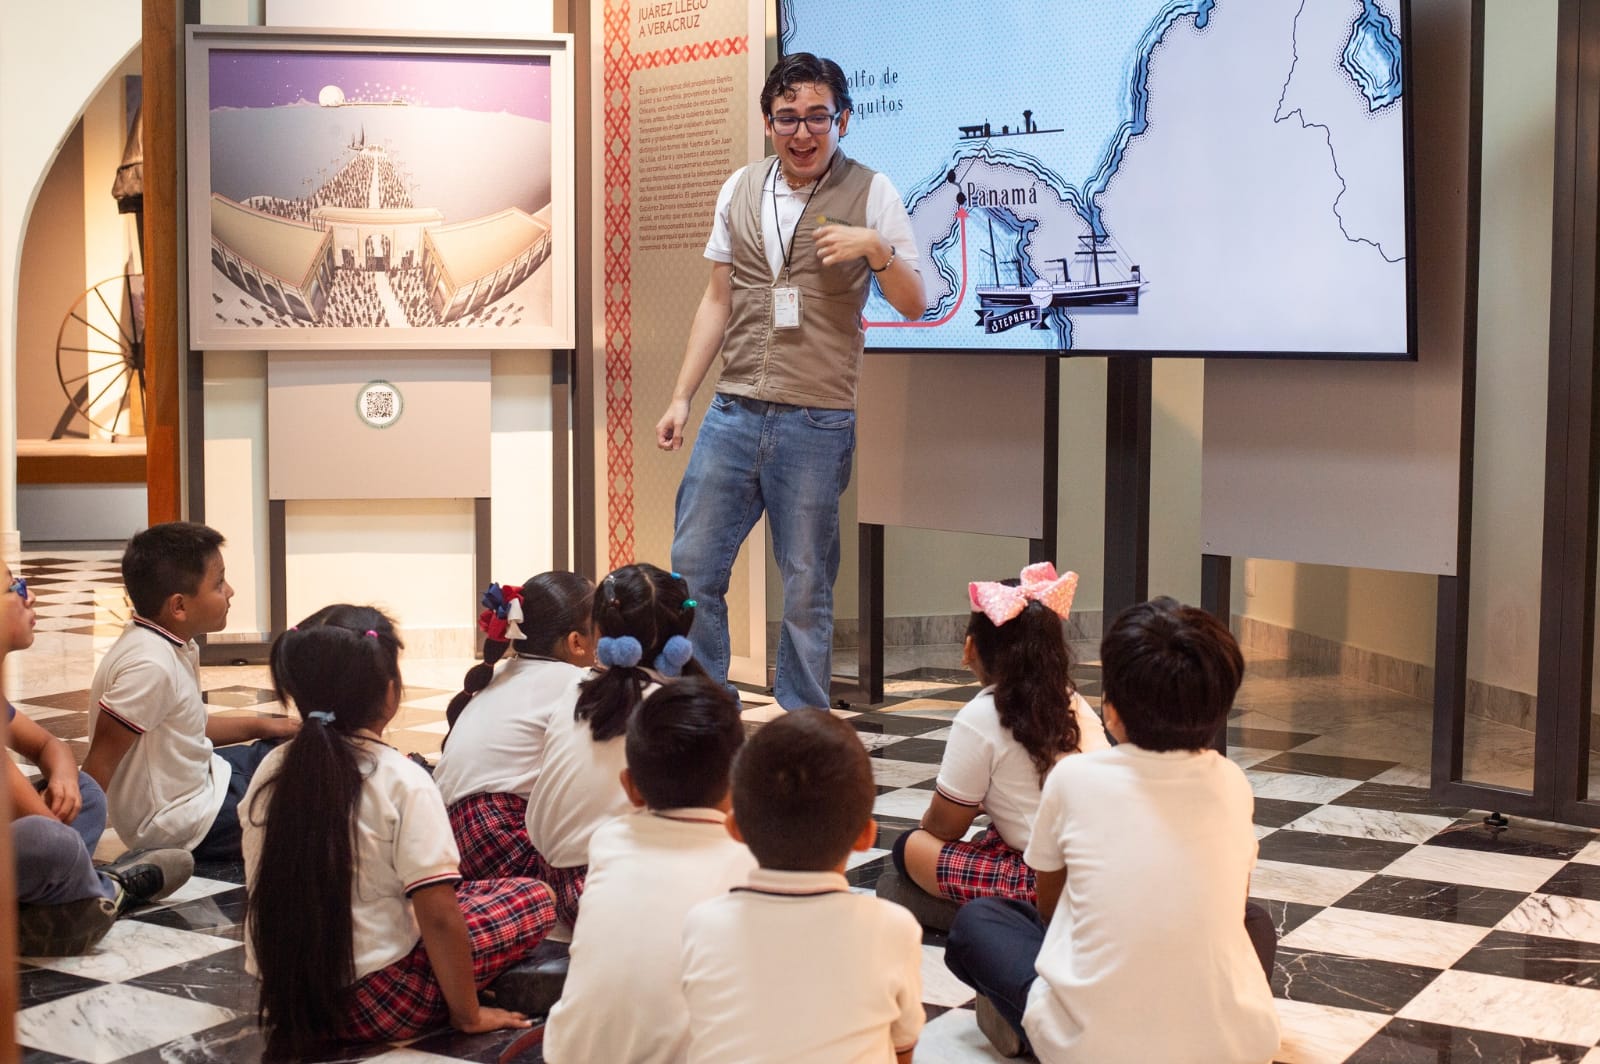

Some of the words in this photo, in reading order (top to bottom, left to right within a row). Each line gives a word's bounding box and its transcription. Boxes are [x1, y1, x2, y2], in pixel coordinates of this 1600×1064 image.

[639, 25, 646, 38] A
[648, 14, 700, 36] VERACRUZ
[847, 70, 874, 88] olfo
[884, 66, 898, 84] de
[967, 182, 1036, 207] Panamá
[992, 310, 1036, 332] STEPHENS
